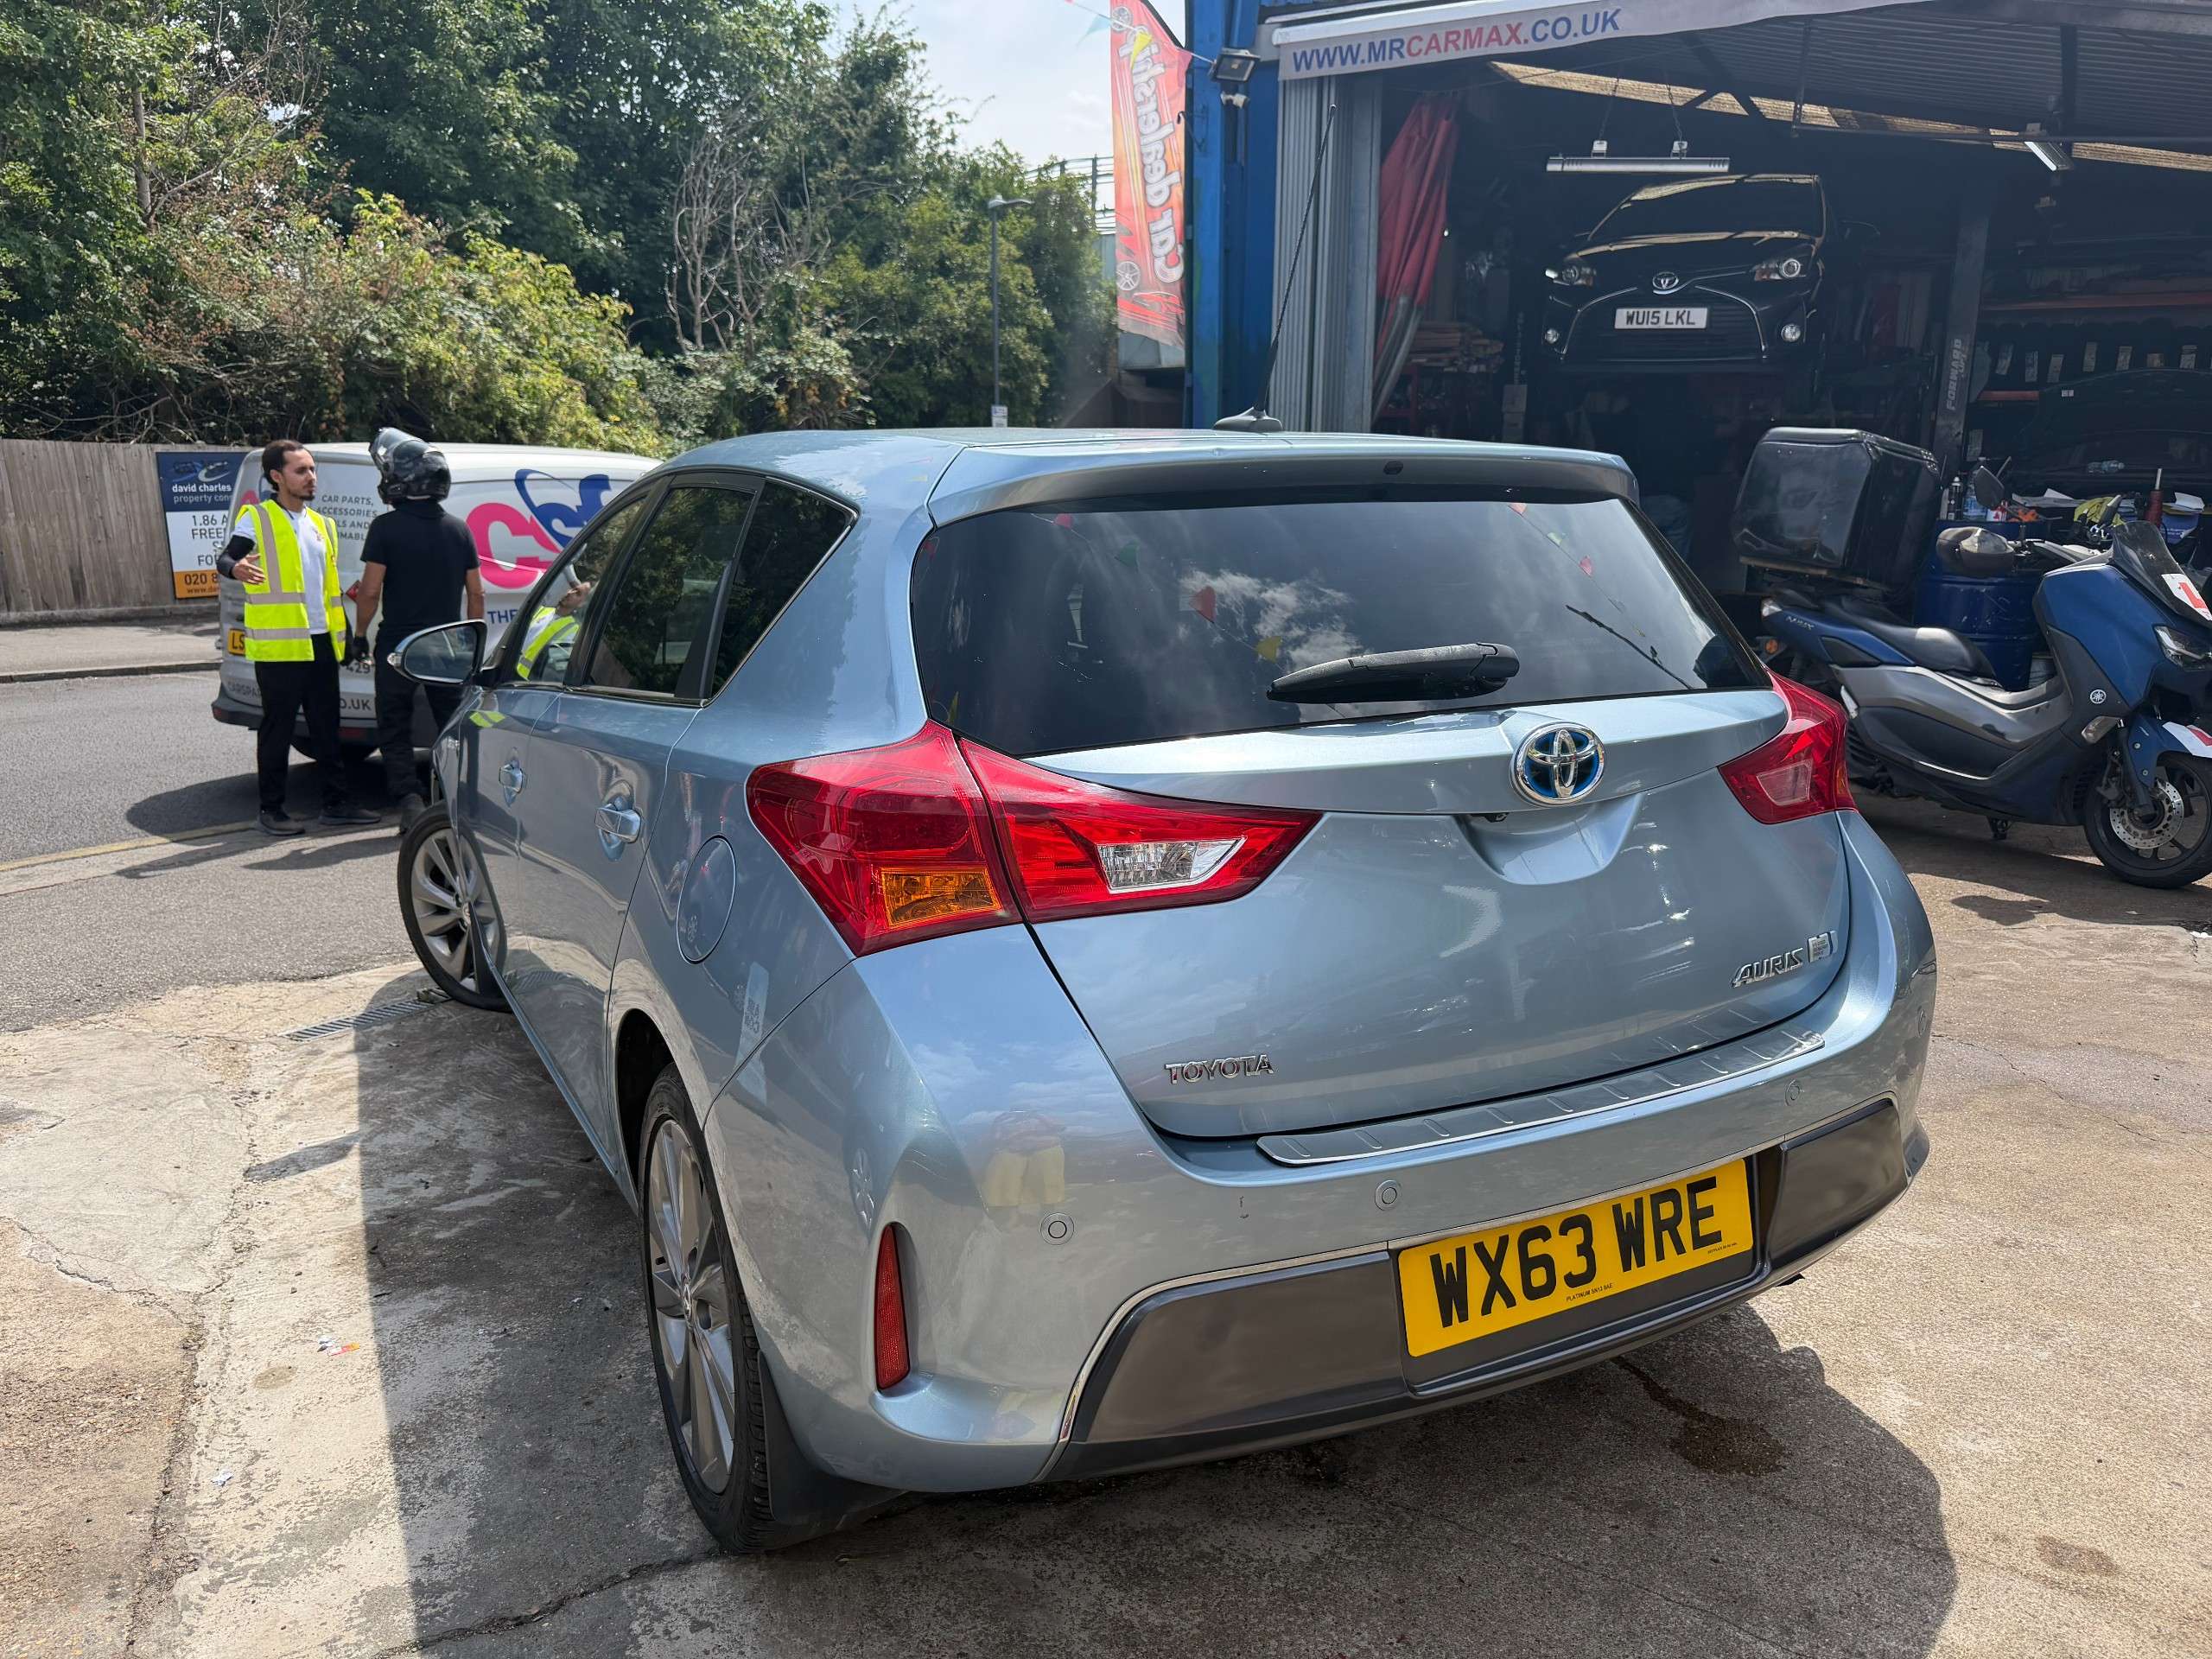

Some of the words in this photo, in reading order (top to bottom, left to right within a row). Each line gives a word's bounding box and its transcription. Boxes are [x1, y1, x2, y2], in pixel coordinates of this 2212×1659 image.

[1293, 9, 1622, 72] WWW.MRCARMAX.CO.UK
[1625, 310, 1661, 326] WU15
[1664, 309, 1695, 326] LKL
[1946, 338, 1962, 410] FORWARD
[172, 483, 197, 493] david
[198, 482, 232, 493] charles
[174, 493, 213, 505] property
[321, 494, 339, 503] CAR
[341, 495, 374, 506] PARTS,
[192, 514, 218, 526] 1.86
[349, 520, 371, 530] AND
[191, 527, 226, 540] FREE
[184, 572, 207, 586] 020
[1732, 947, 1804, 988] AURIS
[1164, 1054, 1274, 1084] TOYOTA
[1429, 1213, 1598, 1329] WX63
[1611, 1175, 1723, 1274] WRE
